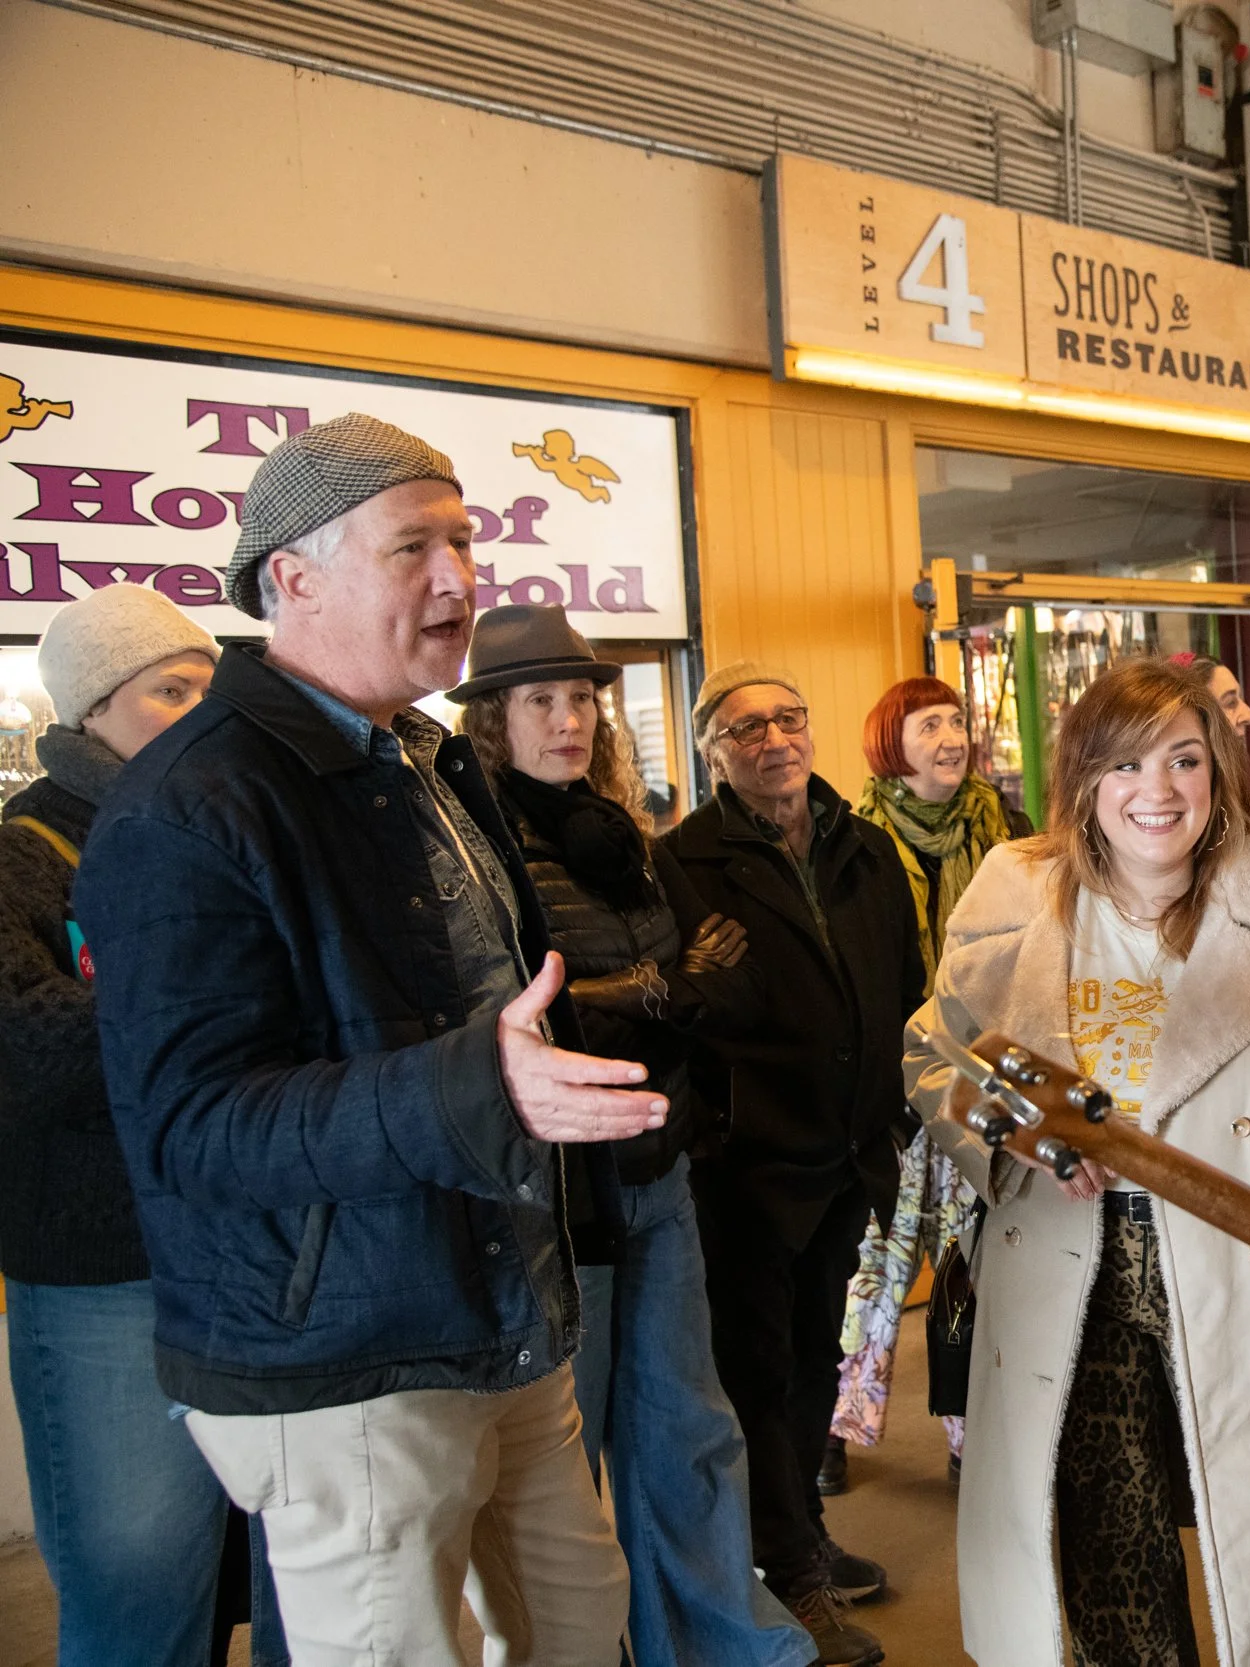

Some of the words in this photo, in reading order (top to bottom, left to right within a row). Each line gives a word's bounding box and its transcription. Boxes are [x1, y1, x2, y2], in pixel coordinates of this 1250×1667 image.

[859, 195, 880, 334] LEVEL
[898, 212, 986, 349] 4
[1050, 250, 1161, 335] SHOPS
[1168, 292, 1191, 332] &
[467, 496, 549, 545] of
